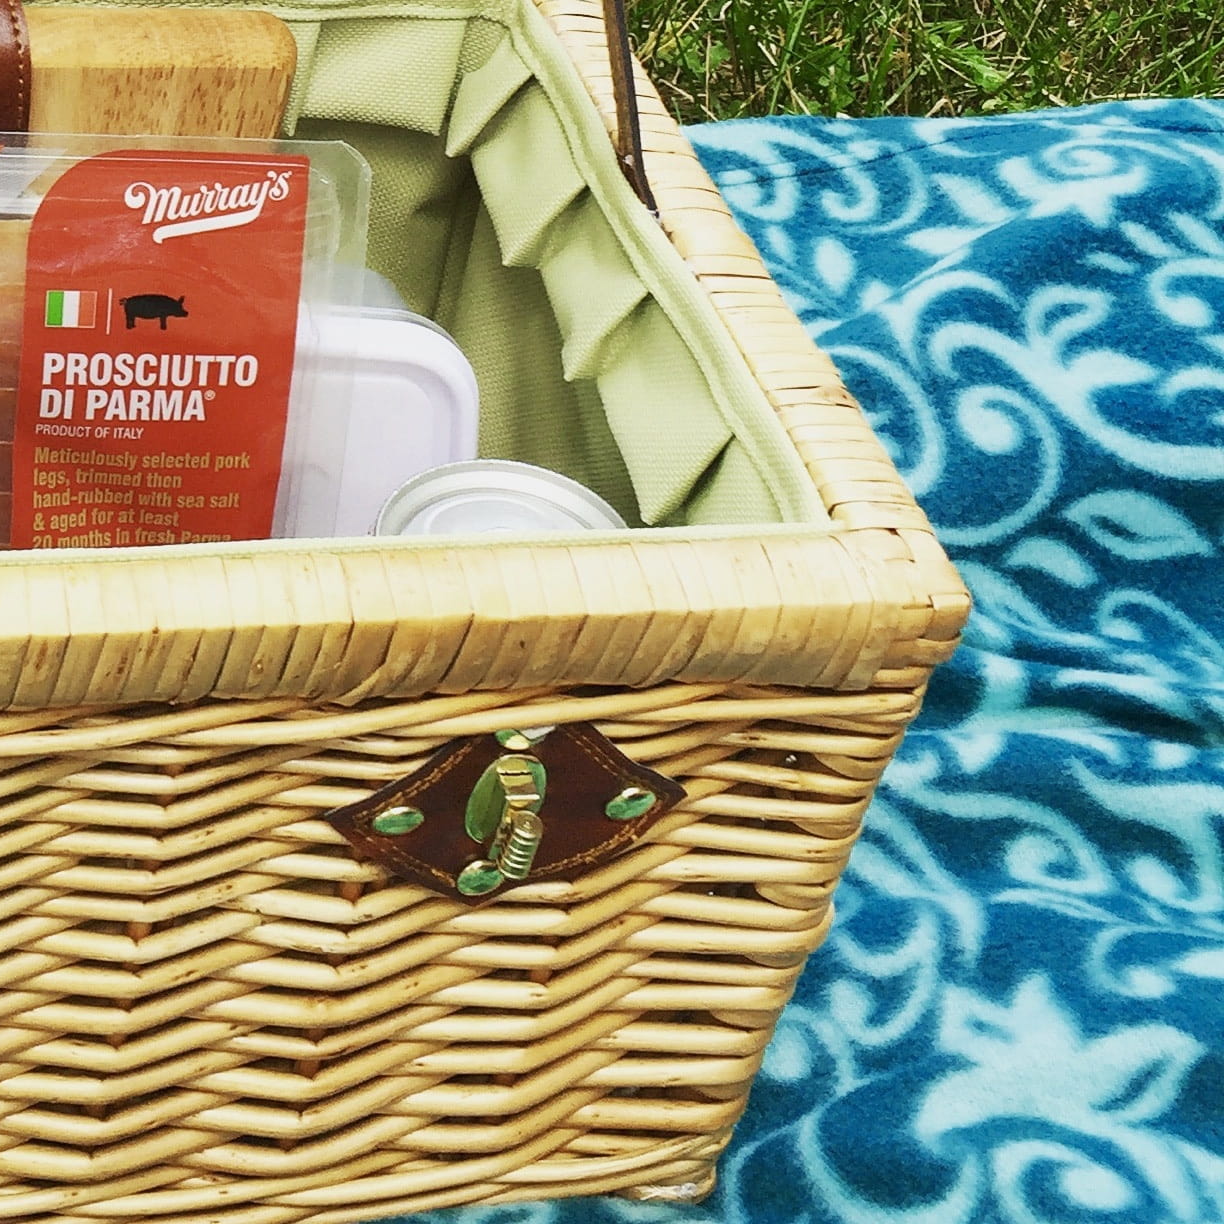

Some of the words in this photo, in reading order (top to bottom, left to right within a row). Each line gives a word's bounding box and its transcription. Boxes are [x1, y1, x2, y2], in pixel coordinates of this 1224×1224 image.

[124, 170, 293, 244] Murray's
[41, 352, 259, 387] PROSCIUTTO
[39, 388, 75, 419] DI
[35, 423, 91, 438] PRODUCT
[94, 426, 111, 439] OF
[113, 427, 144, 440] ITALY
[34, 446, 137, 471] Meticulously
[142, 451, 211, 469] selected
[214, 451, 251, 473] pork
[33, 468, 71, 489] legs,
[76, 468, 142, 487] trimmed
[146, 472, 182, 489] then
[33, 487, 134, 509] hand-rubbed
[138, 491, 172, 507] with
[176, 494, 205, 508] sea
[209, 492, 240, 508] salt
[33, 512, 45, 532] &
[50, 508, 87, 533] aged
[91, 507, 114, 525] for
[117, 508, 135, 524] at
[138, 509, 179, 527] least
[32, 534, 53, 549] 20
[57, 528, 112, 549] months
[116, 527, 130, 545] in
[135, 527, 176, 544] fresh
